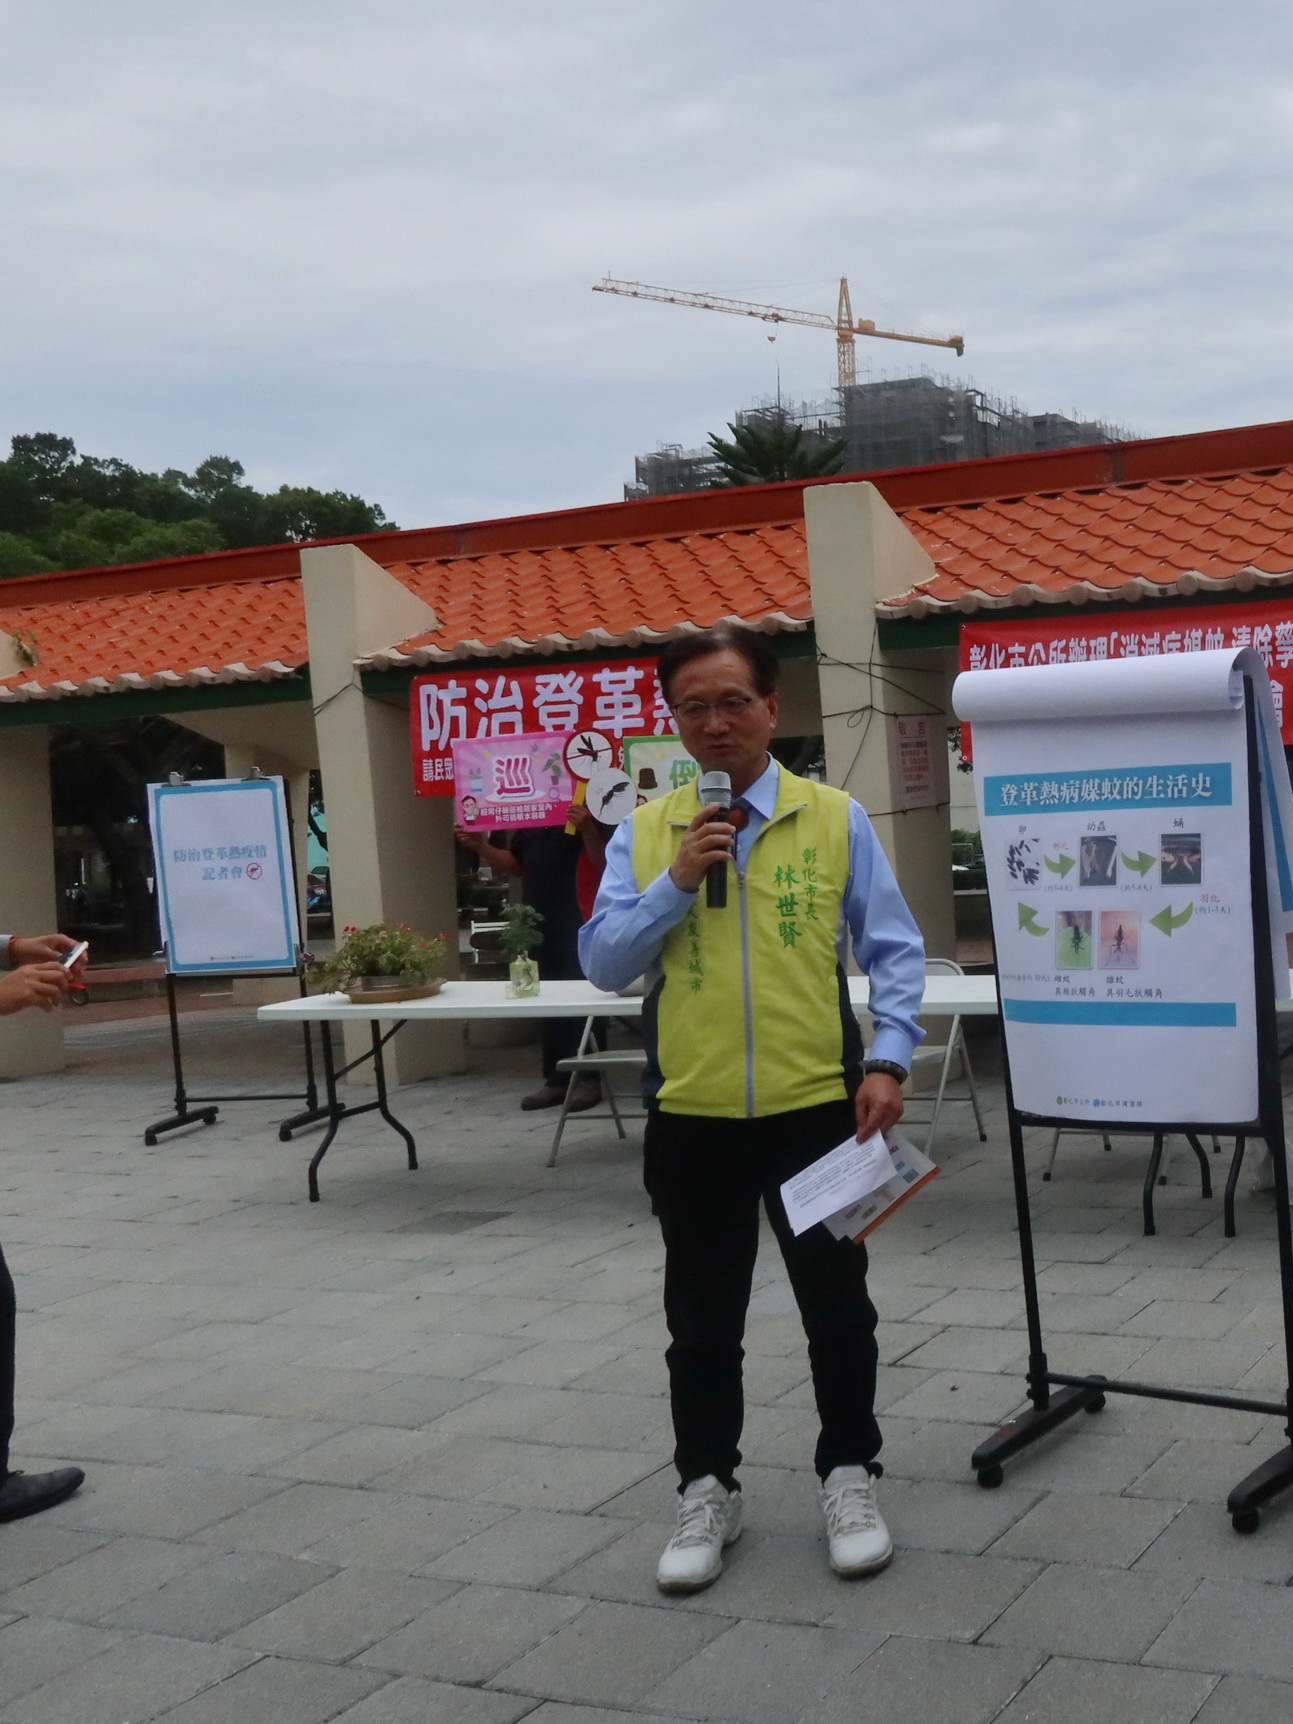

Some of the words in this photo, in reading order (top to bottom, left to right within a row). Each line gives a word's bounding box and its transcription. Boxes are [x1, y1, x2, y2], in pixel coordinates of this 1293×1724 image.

[493, 753, 535, 799] 巡
[1000, 772, 1213, 807] 登革熱病媒蚊的生活史
[1086, 820, 1107, 832] 幼蟲
[174, 845, 267, 862] 防治登革熱疫情
[202, 865, 243, 881] 記者會
[802, 847, 819, 921] 彰化市長
[773, 864, 802, 949] 林世賢
